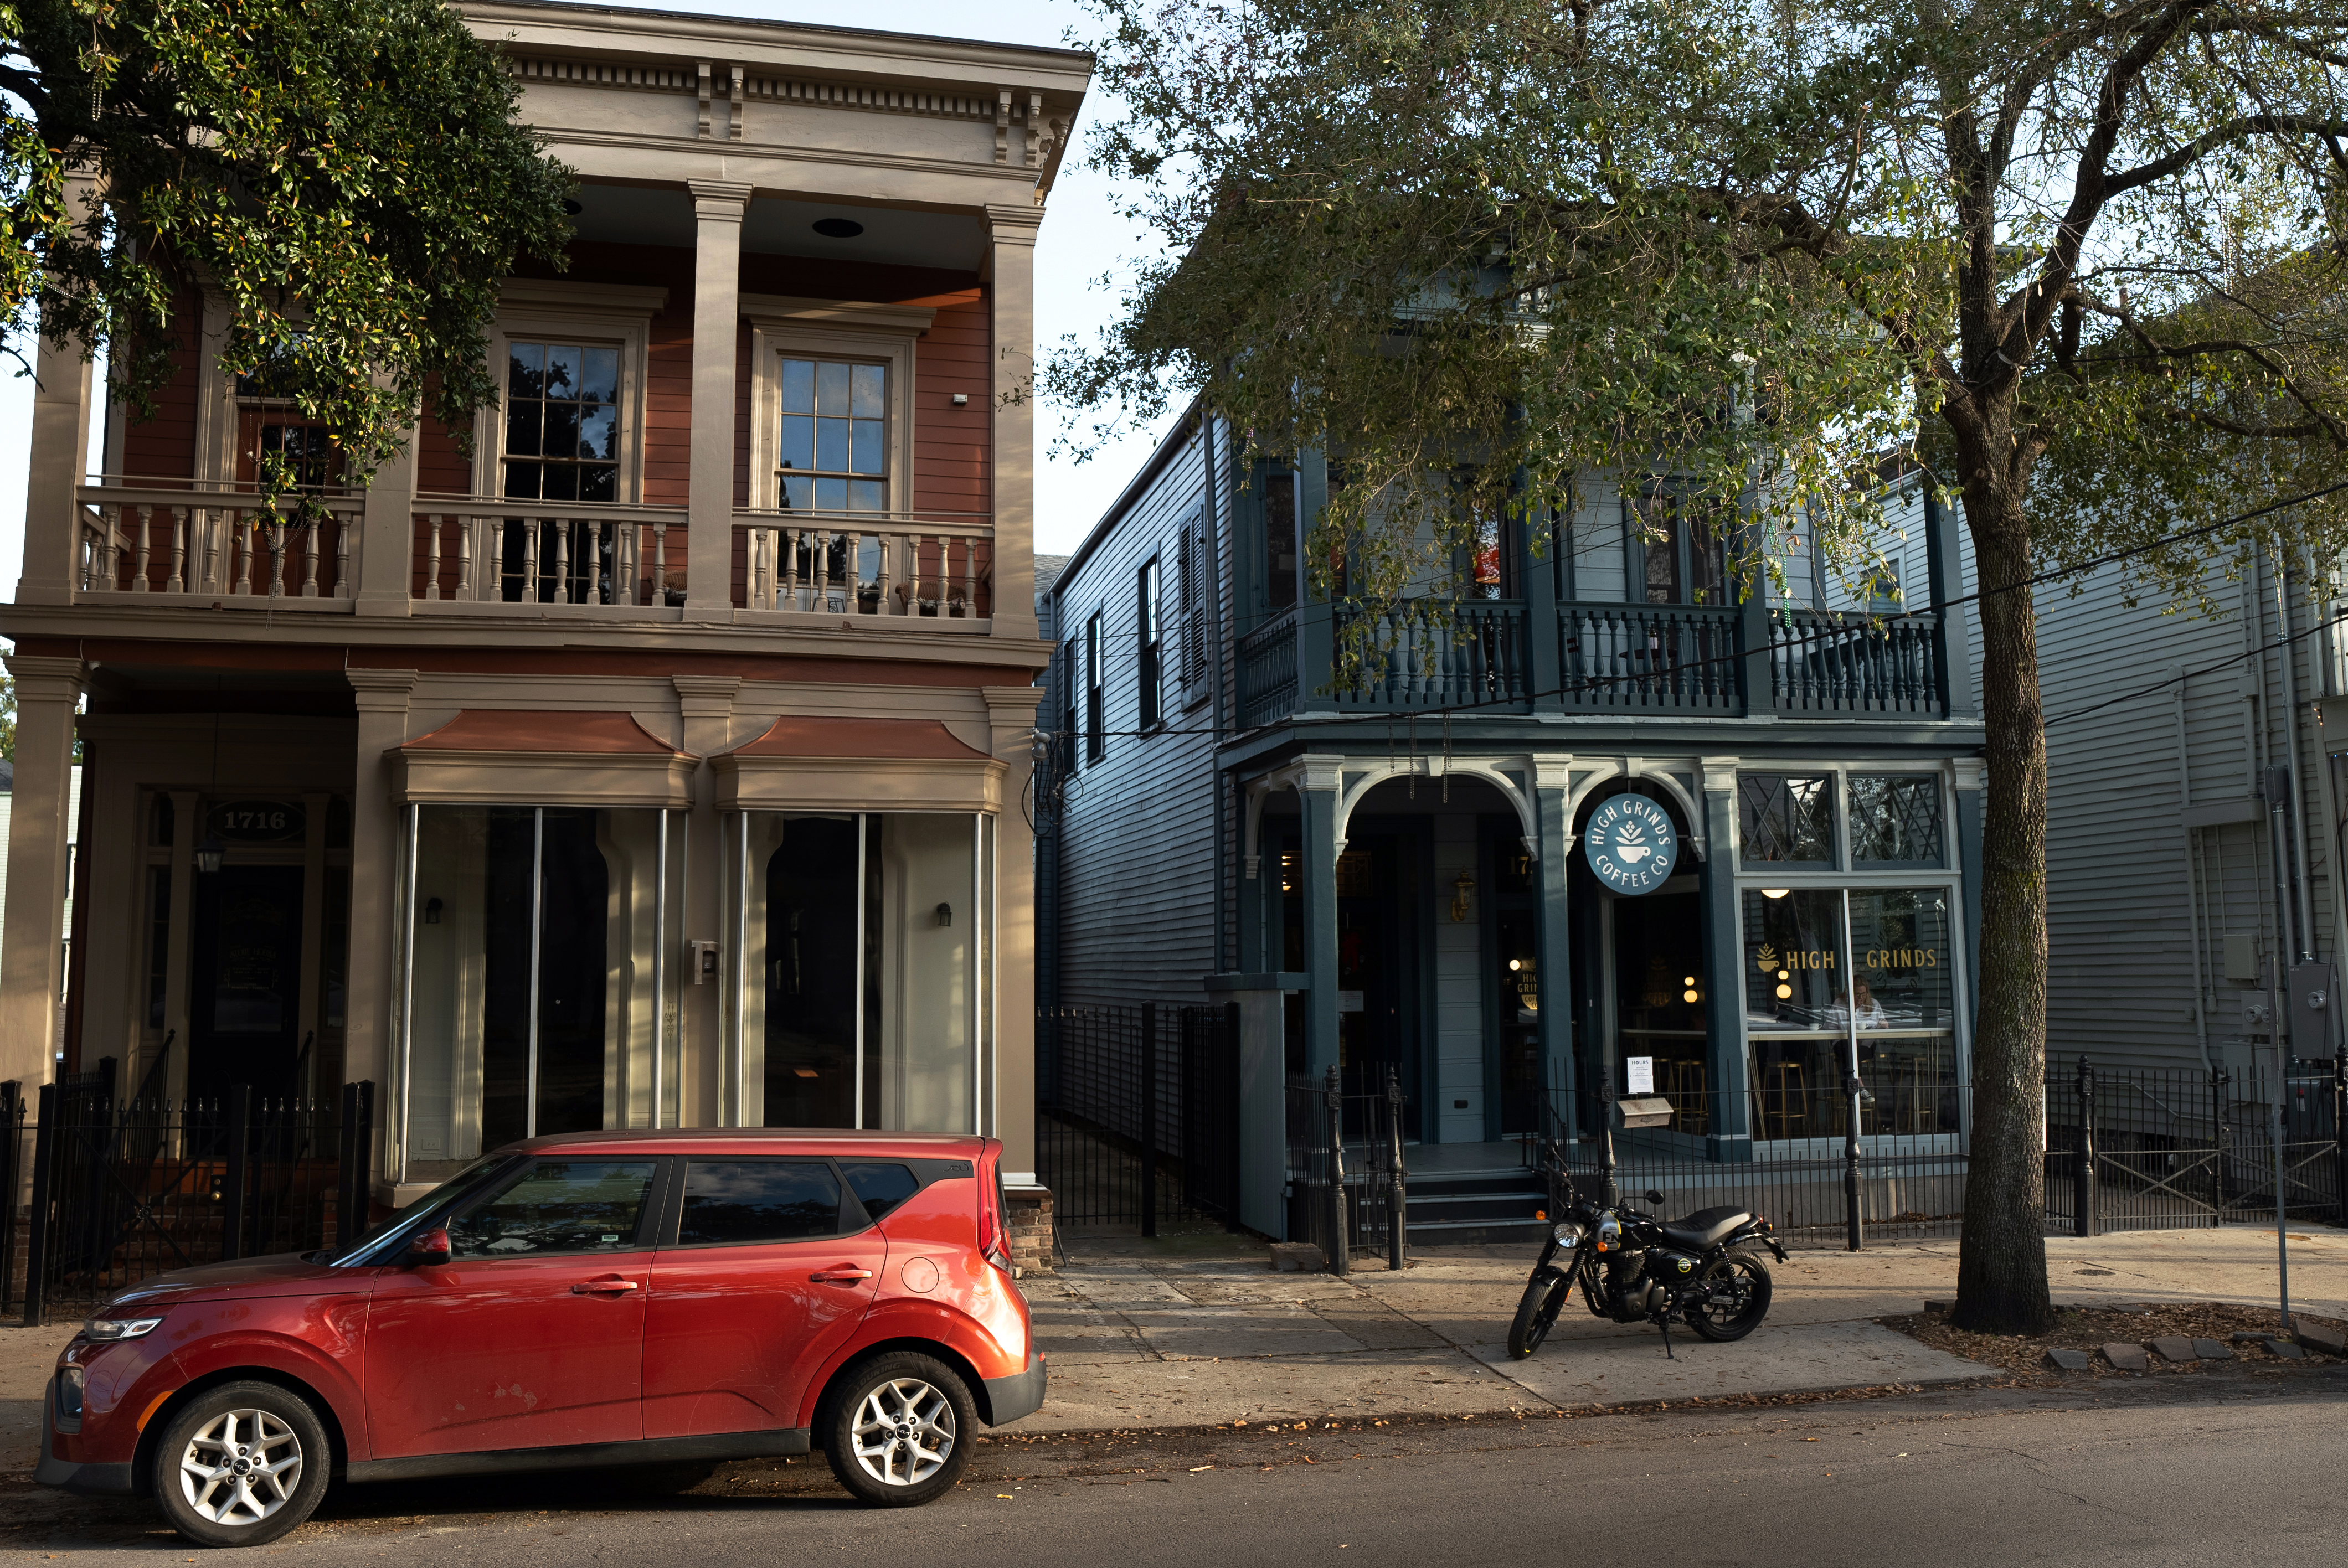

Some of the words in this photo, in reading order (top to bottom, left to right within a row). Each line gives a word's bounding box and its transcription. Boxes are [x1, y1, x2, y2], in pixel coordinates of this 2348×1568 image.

[224, 811, 286, 830] 1716
[1592, 806, 1618, 844] HIGH
[1623, 801, 1670, 845] GRINDS
[1508, 856, 1533, 875] 17
[1597, 855, 1649, 886] COFFEE
[1651, 855, 1667, 875] CO
[230, 947, 251, 958] STORE
[254, 947, 276, 959] HOURS
[1787, 951, 1834, 969] HIGH
[1867, 950, 1935, 967] GRINDS
[853, 1362, 902, 1391] TOURING
[907, 1472, 953, 1501] 205/60R16
